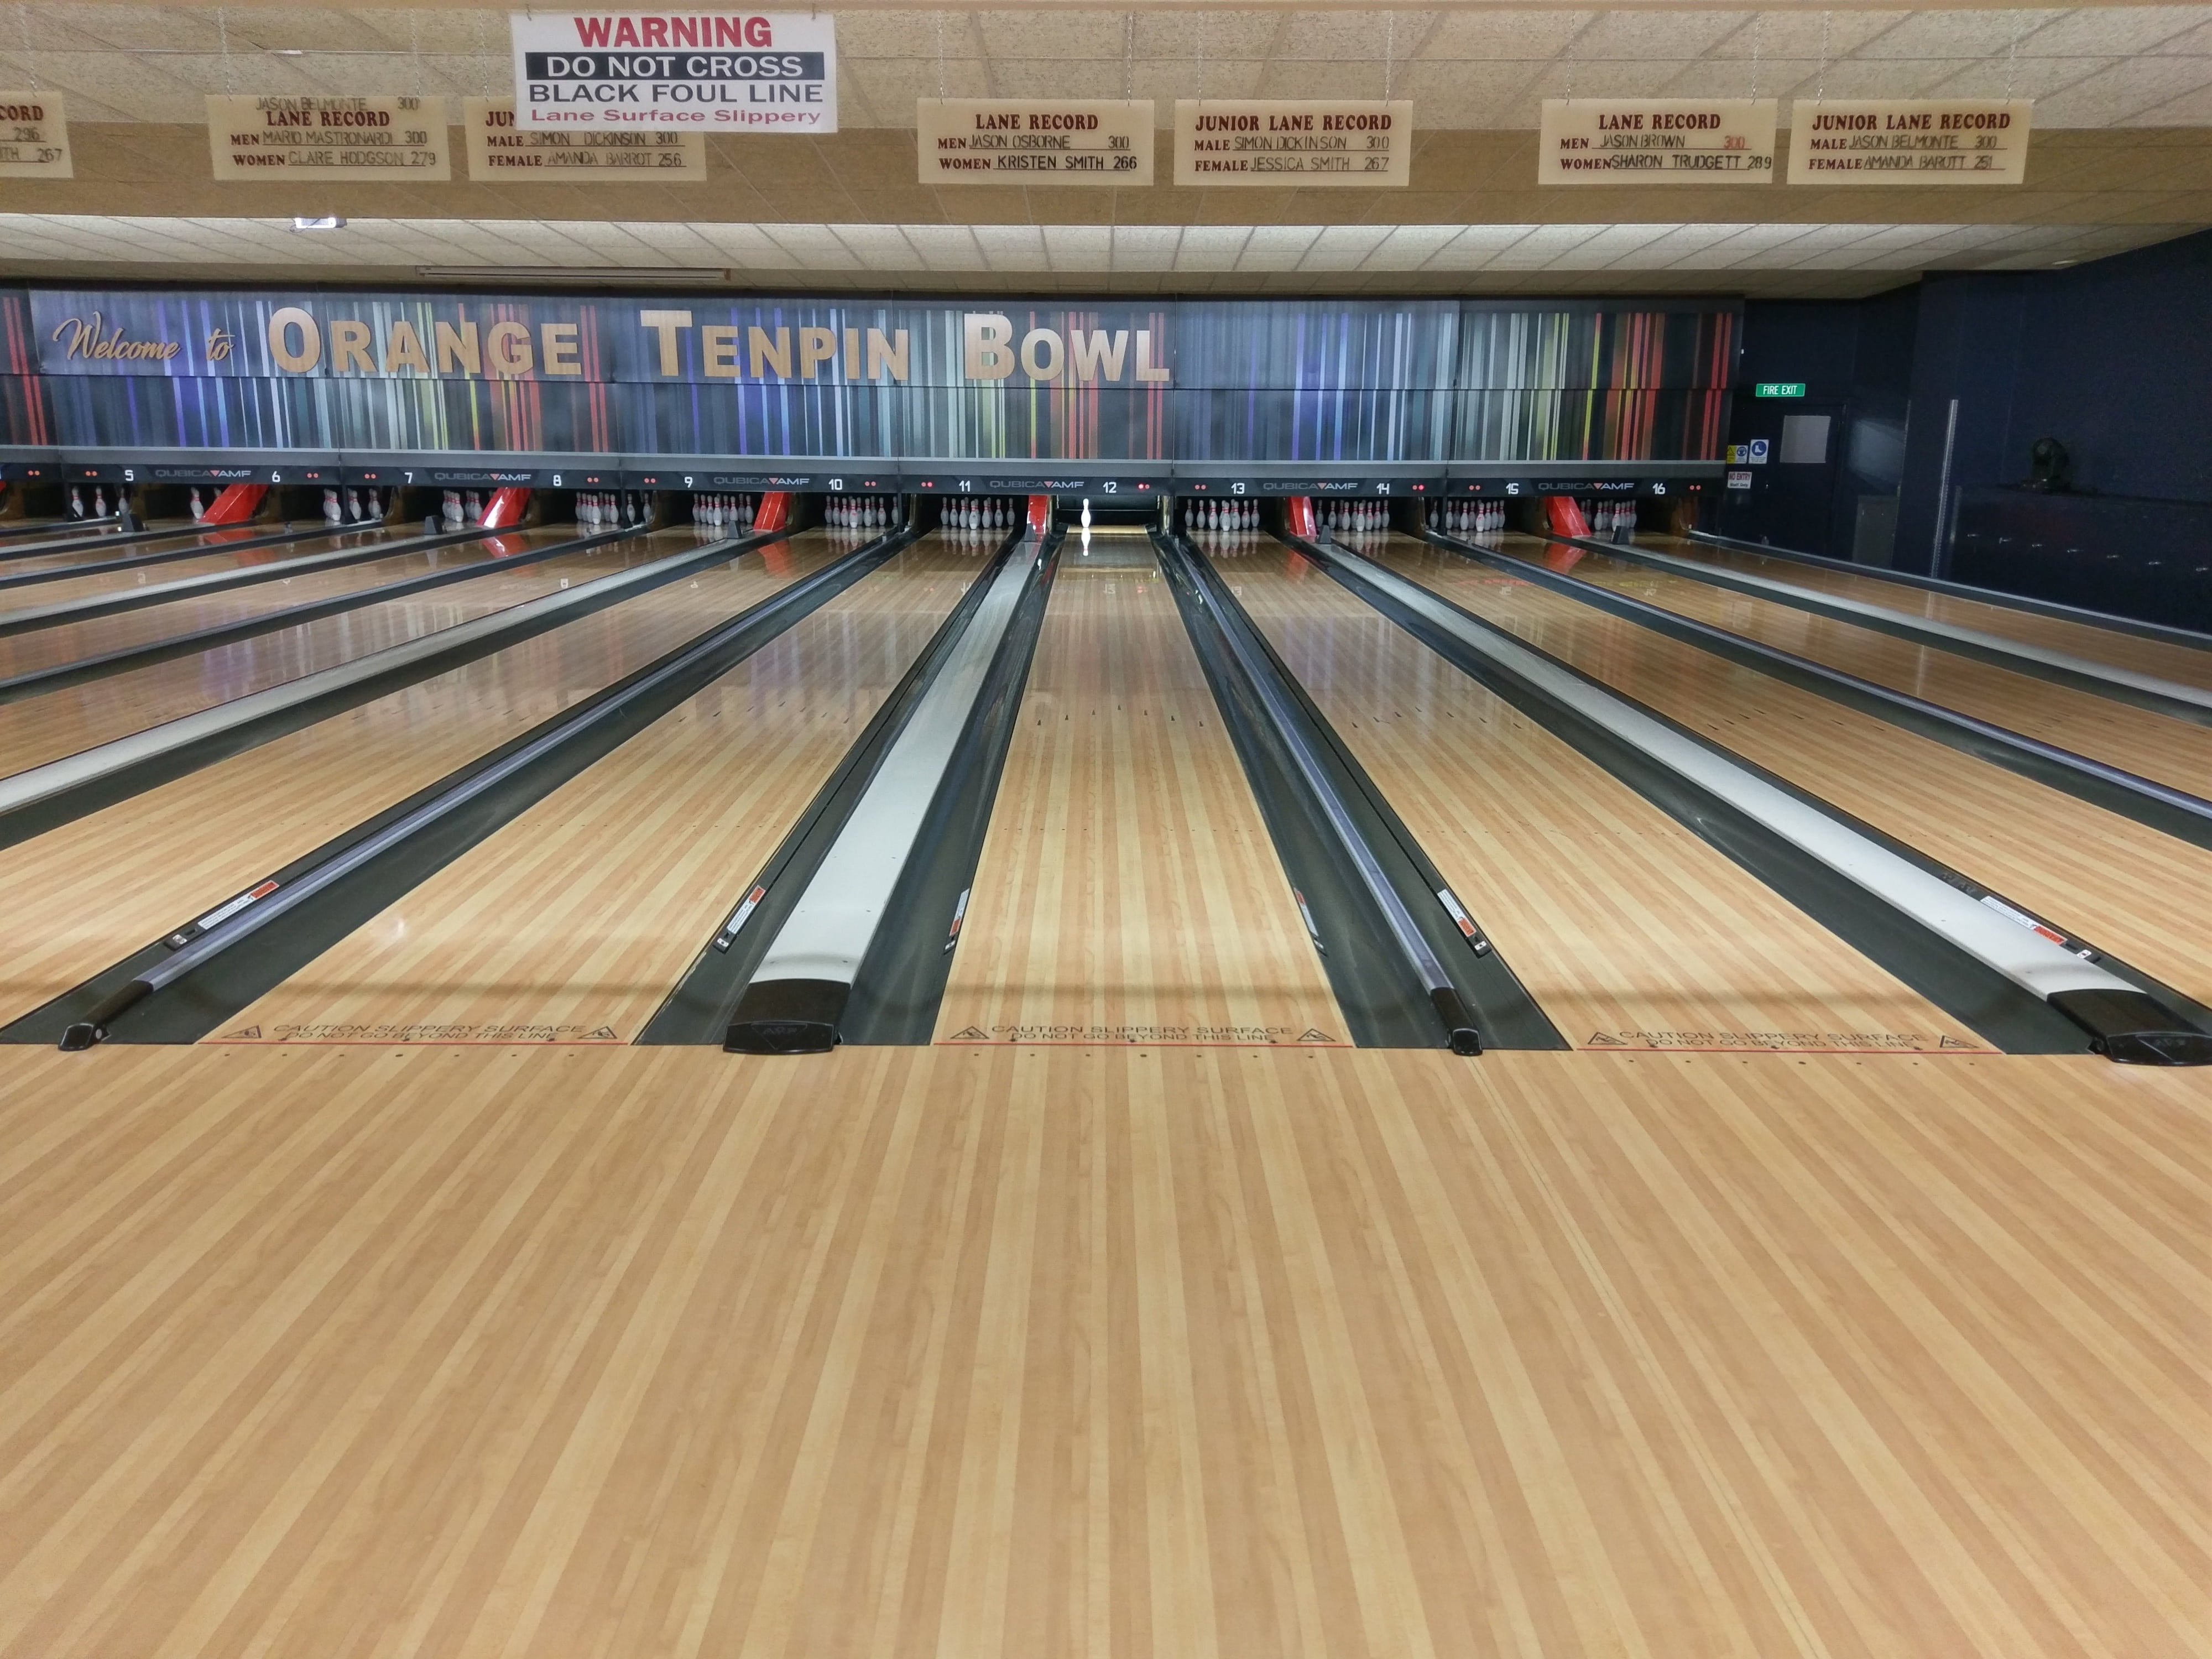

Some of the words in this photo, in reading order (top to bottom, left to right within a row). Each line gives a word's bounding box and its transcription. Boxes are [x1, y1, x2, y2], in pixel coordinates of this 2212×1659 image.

[573, 17, 771, 48] WARNING
[547, 56, 596, 77] DO
[609, 56, 675, 77] NOT
[686, 55, 802, 77] CROSS
[529, 84, 638, 103] BLACK
[652, 84, 737, 103] FOUL
[749, 84, 823, 103] LINE
[256, 97, 296, 111] JASON
[266, 111, 312, 127] LANE
[320, 111, 390, 127] RECORD
[531, 109, 594, 122] Lane
[603, 109, 706, 122] Surface
[714, 109, 821, 125] Slippery
[975, 114, 1020, 130] LANE
[1029, 114, 1098, 130] RECORD
[1195, 115, 1260, 131] JUNIOR
[1269, 114, 1313, 131] LANE
[1322, 114, 1392, 131] RECORD
[1599, 114, 1644, 130] LANE
[1652, 114, 1721, 130] RECORD
[1812, 114, 1877, 131] JUNIOR
[1886, 114, 1932, 130] LANE
[1940, 113, 2010, 130] RECORD
[230, 134, 259, 145] MEN
[263, 130, 301, 144] MARIO
[405, 131, 428, 144] 300
[487, 135, 523, 147] MALE
[530, 132, 570, 145] SIMON
[584, 132, 646, 145] DICKINSON
[655, 132, 677, 145] 300
[938, 138, 966, 149] MEN
[969, 134, 1007, 148] JASON
[1013, 135, 1070, 149] OSBORNE
[1108, 135, 1130, 149] 300
[1194, 139, 1230, 151] MALE
[1234, 135, 1272, 150] SIMON
[1276, 136, 1347, 150] DICKINSON
[1366, 135, 1390, 150] 300
[1560, 138, 1589, 149] MEN
[1600, 134, 1637, 148] JASON
[1641, 134, 1686, 148] BROWN
[1724, 135, 1746, 149] 300
[1811, 139, 1847, 150] MALE
[1849, 134, 1888, 148] JASON
[1892, 134, 1959, 149] BELMONTE
[1974, 135, 1997, 148] 300
[37, 148, 62, 163] 267
[233, 154, 285, 166] WOMEN
[288, 151, 333, 165] CLARE
[340, 151, 404, 165] HODGSON
[411, 151, 436, 165] 279
[488, 155, 542, 166] FEMALE
[547, 152, 598, 165] AMANDA
[658, 153, 682, 166] 256
[939, 158, 991, 170] WOMEN
[998, 155, 1056, 169] KRISTEN
[1065, 155, 1104, 170] SMITH
[1114, 156, 1138, 170] 266
[1561, 158, 1612, 170] WOMEN
[1611, 154, 1662, 169] SHARON
[1672, 154, 1741, 169] TRUDGETT
[1747, 155, 1772, 169] 289
[1809, 158, 1863, 170] FEMALE
[1864, 155, 1913, 169] AMANDA
[1974, 155, 1993, 169] 251
[1194, 160, 1248, 171] FEMALE
[1250, 157, 1304, 171] JESSICA
[1311, 157, 1350, 171] SMITH
[1365, 157, 1390, 171] 267
[53, 311, 181, 361] Welcome
[206, 328, 235, 361] to
[268, 307, 582, 375] ORANGE
[640, 310, 909, 380] TENPIN
[964, 314, 1170, 382] BOWL
[1762, 385, 1779, 395] FIRE
[1781, 385, 1797, 395] EXIT
[125, 469, 134, 481] 5
[272, 471, 280, 483] 6
[404, 472, 413, 484] 7
[553, 474, 562, 486] 8
[684, 476, 693, 488] 9
[828, 479, 842, 491] 10
[959, 480, 971, 492] 11
[1103, 482, 1117, 493] 12
[1231, 483, 1245, 494] 13
[1376, 483, 1390, 494] 14
[1506, 483, 1519, 494] 15
[1652, 483, 1666, 494] 16
